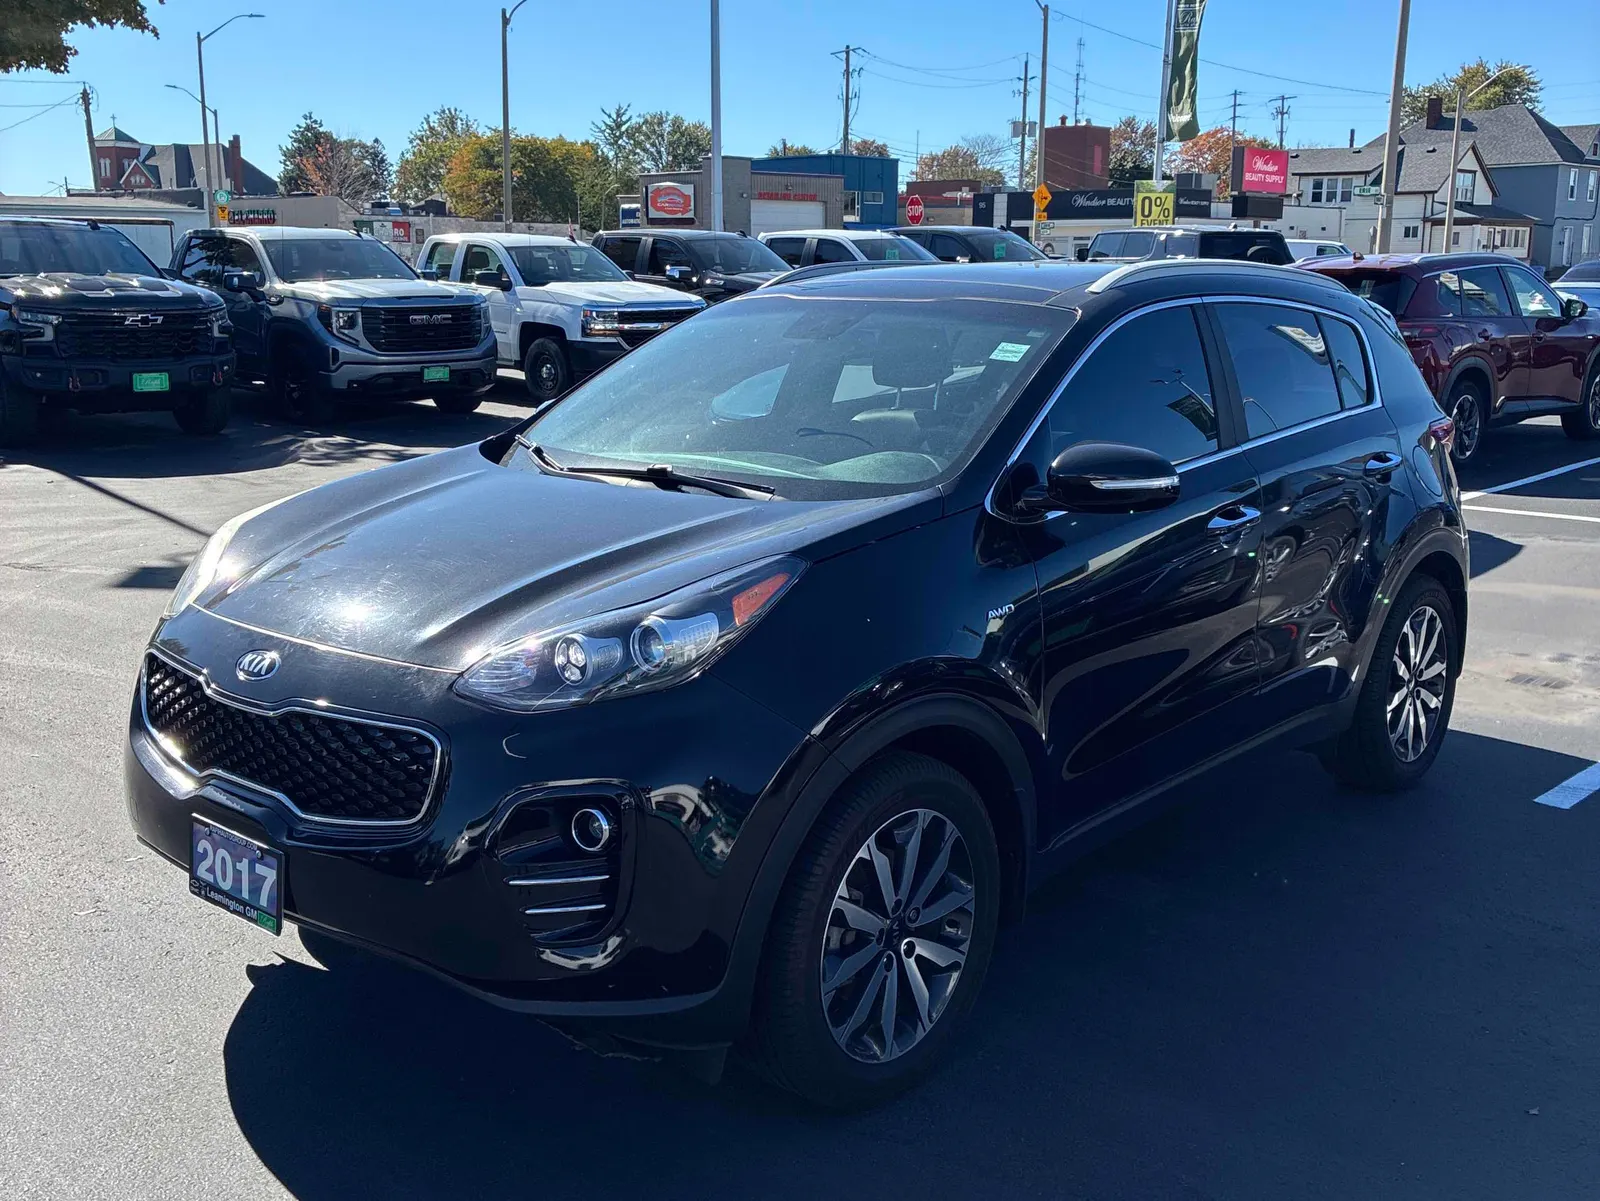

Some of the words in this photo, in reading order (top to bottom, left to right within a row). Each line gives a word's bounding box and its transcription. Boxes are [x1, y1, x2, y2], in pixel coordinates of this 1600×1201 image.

[1252, 155, 1279, 172] Windsor
[1245, 172, 1264, 182] BEAUTY
[1265, 174, 1284, 184] SUPPLY
[979, 201, 987, 209] 95
[1071, 192, 1106, 208] Windsor
[1107, 198, 1135, 206] BEAUTY
[1140, 195, 1171, 218] 0%
[907, 205, 924, 217] STOP
[409, 314, 452, 325] GMC
[988, 603, 1015, 619] AWD
[239, 653, 272, 675] KIA
[196, 839, 277, 908] 2017
[206, 886, 245, 914] Leamington
[245, 906, 258, 921] GM
